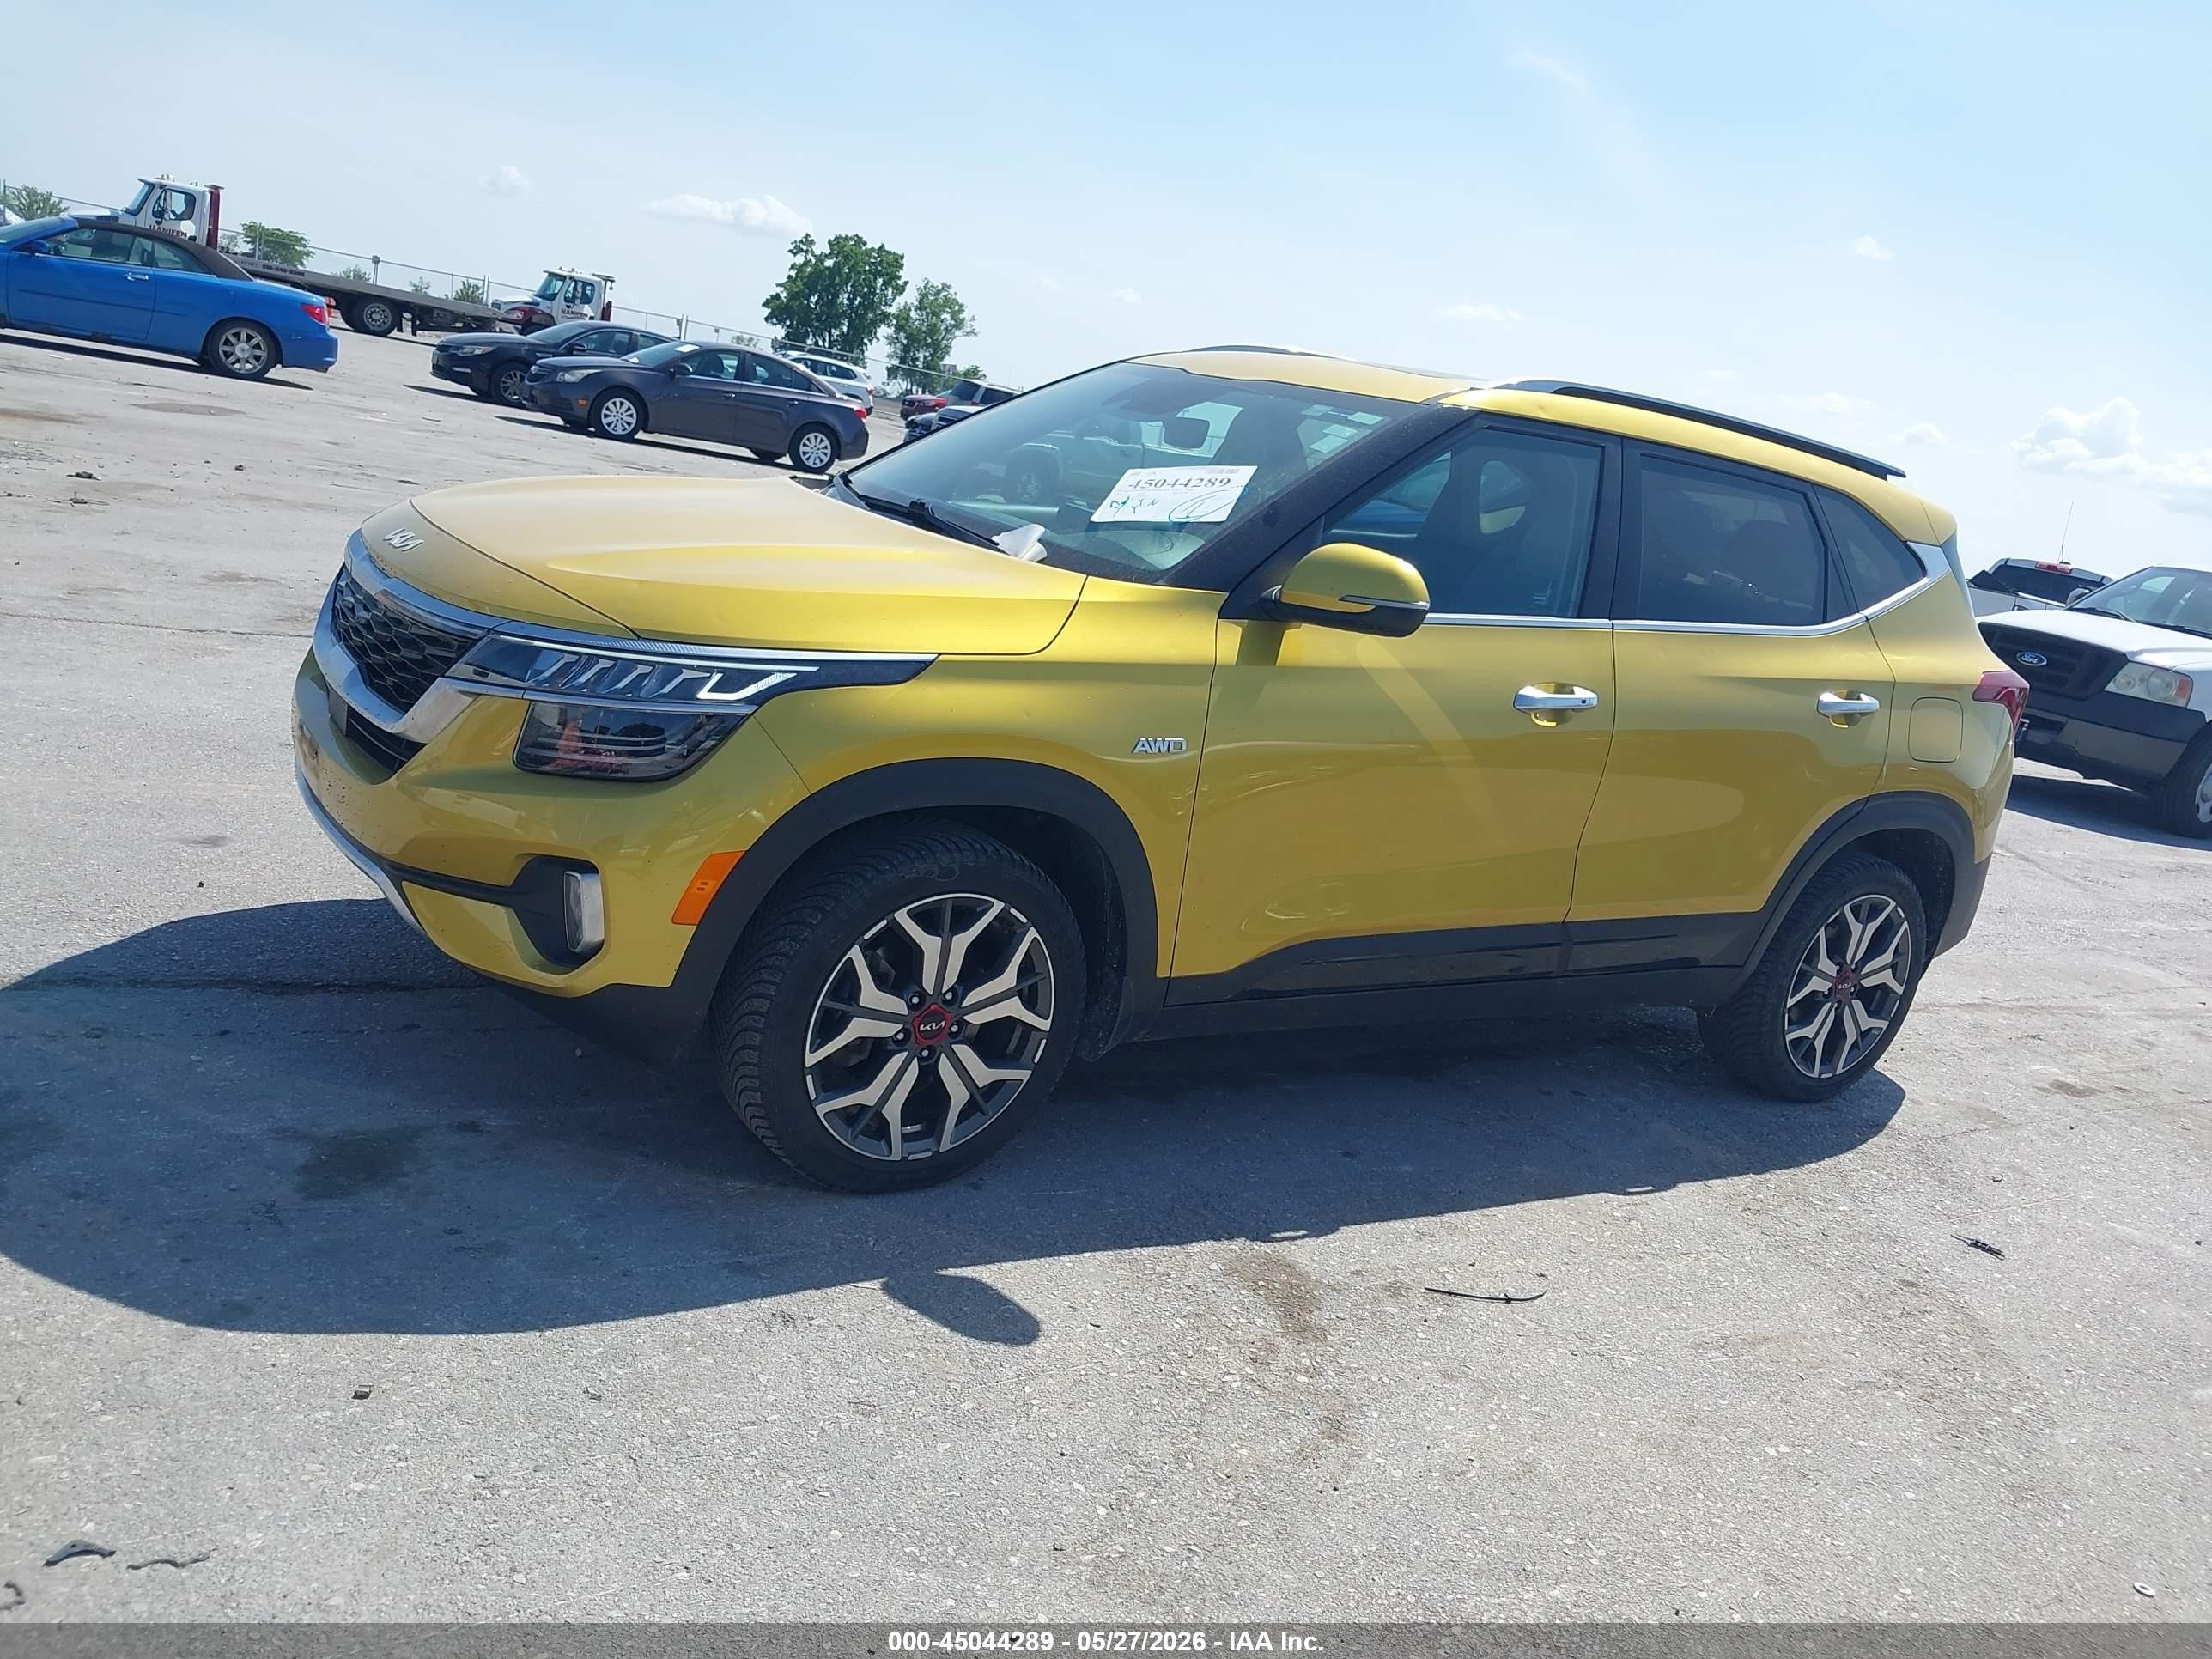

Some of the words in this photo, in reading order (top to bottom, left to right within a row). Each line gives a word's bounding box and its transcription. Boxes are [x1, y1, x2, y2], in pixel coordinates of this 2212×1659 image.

[1127, 477, 1231, 489] 45044289
[2021, 653, 2040, 664] Ford
[1132, 737, 1188, 754] AWD
